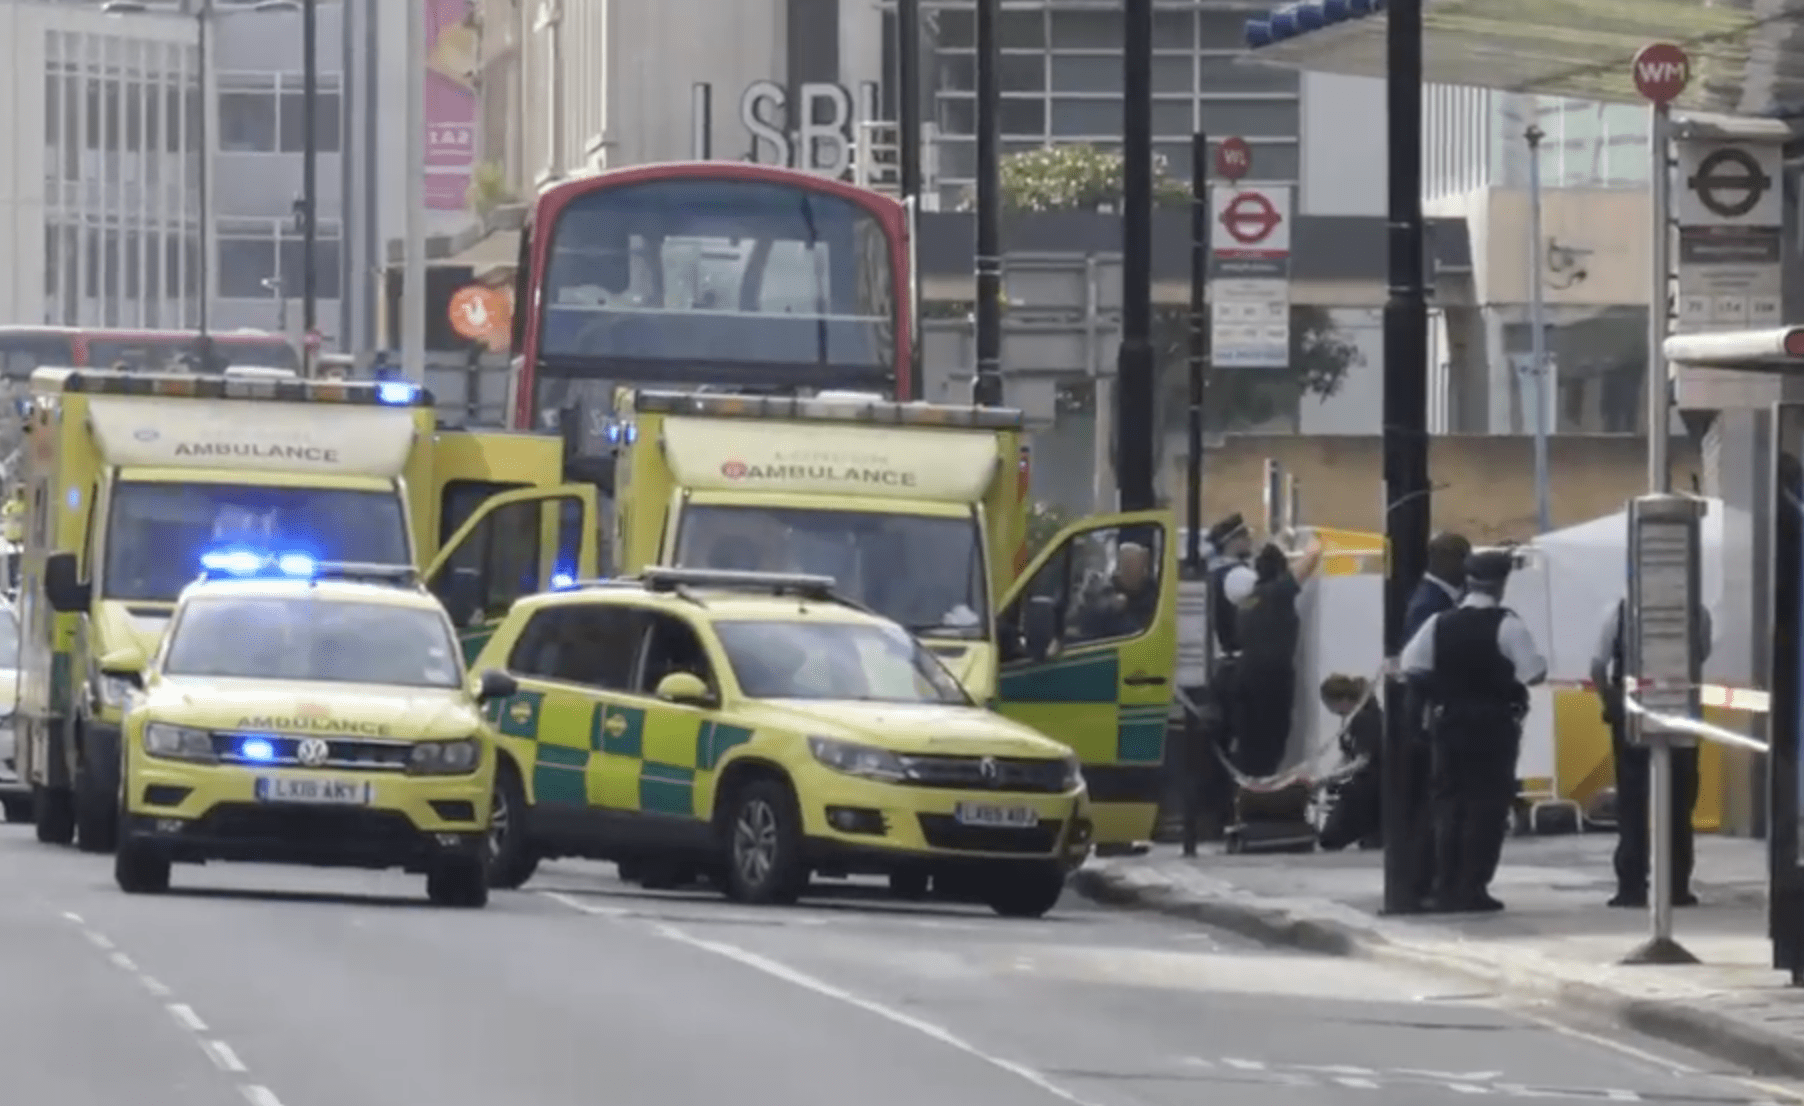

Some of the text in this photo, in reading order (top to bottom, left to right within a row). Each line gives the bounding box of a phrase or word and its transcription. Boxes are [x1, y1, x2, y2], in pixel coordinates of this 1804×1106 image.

[1638, 61, 1685, 83] WM
[174, 443, 340, 463] AMBULANCE
[747, 464, 917, 487] AMBULANCE
[236, 716, 391, 736] AMBULANCE
